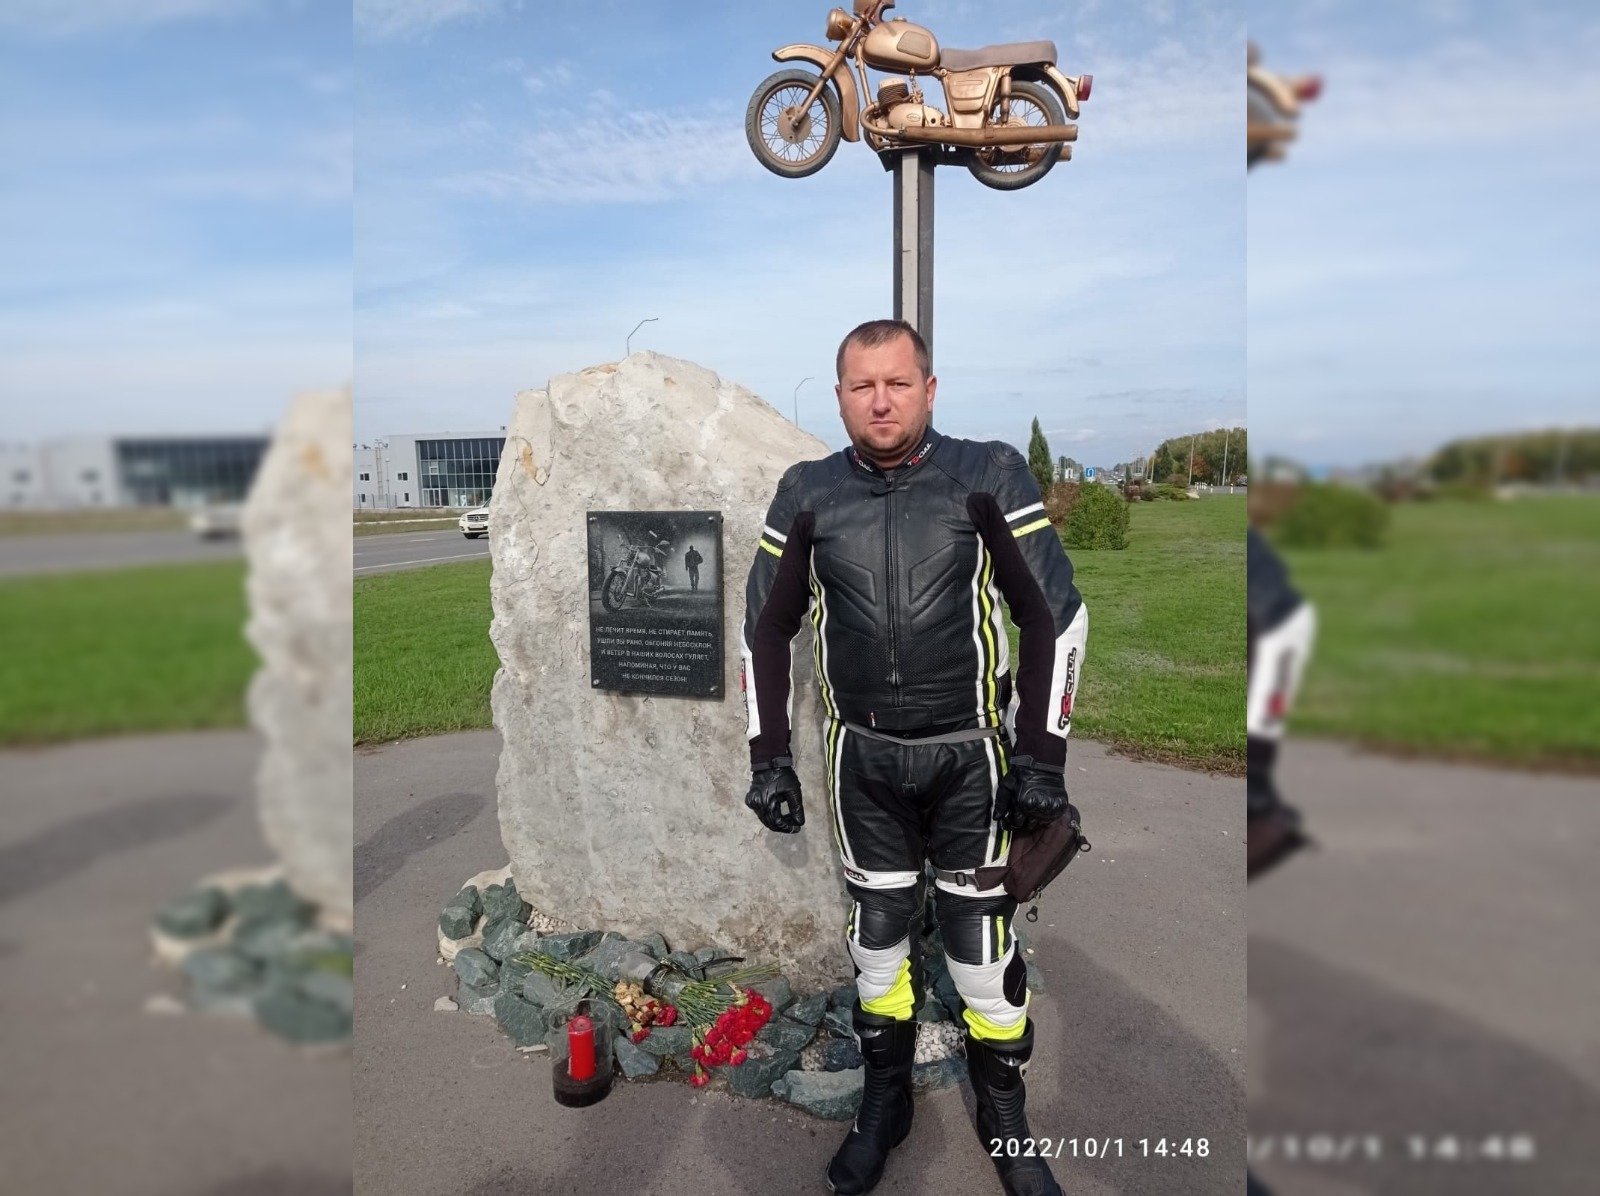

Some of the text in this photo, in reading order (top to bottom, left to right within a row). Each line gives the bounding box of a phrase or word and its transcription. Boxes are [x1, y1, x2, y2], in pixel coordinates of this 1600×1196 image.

[605, 626, 625, 634] ЛЕЧИТ
[658, 628, 685, 636] СТИРАЕТ
[618, 661, 658, 670] НАПОМИНАЯ,
[622, 672, 630, 680] НЕ
[631, 673, 664, 681] КОНЧИЛСЯ
